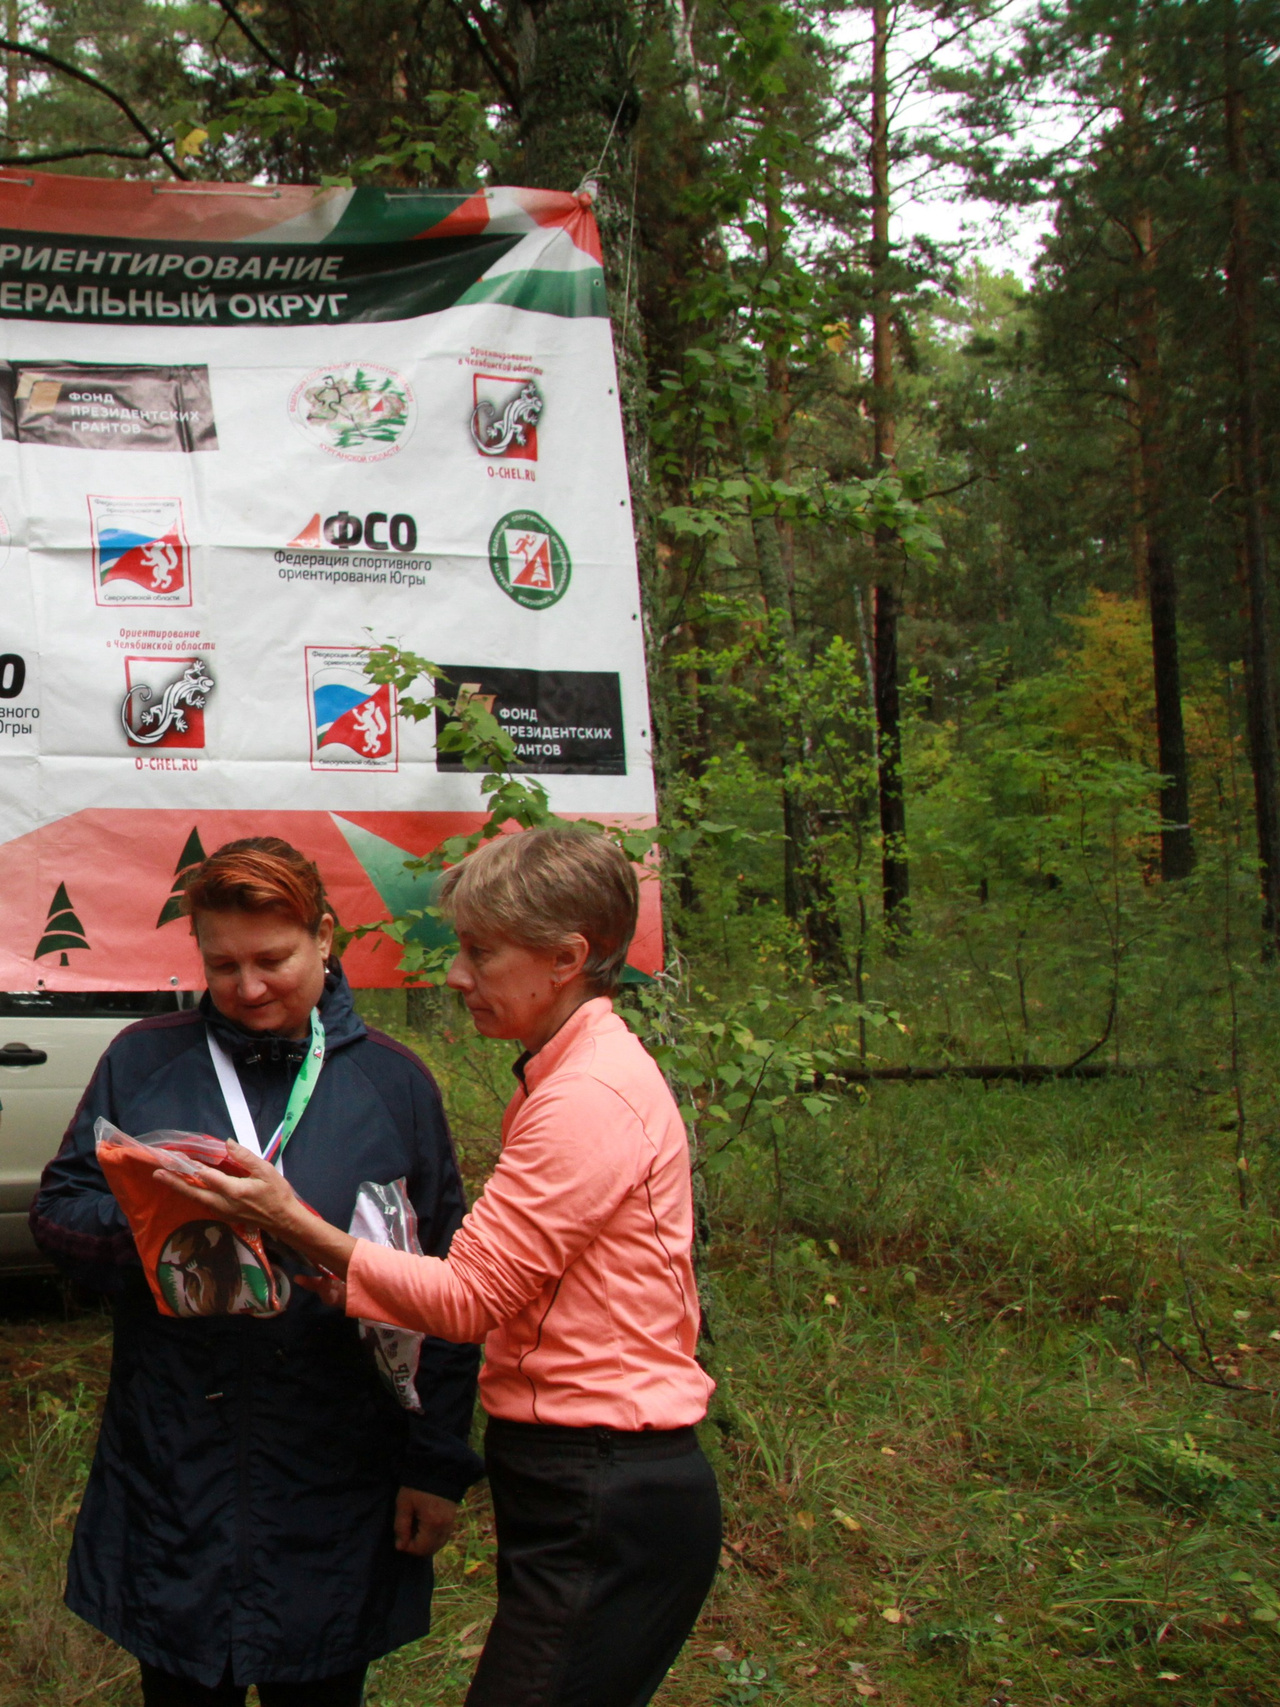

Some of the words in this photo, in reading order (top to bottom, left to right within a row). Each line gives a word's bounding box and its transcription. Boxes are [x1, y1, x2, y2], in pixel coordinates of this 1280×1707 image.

[228, 293, 348, 319] ОКРУГ
[470, 347, 532, 360] Ориентирование
[69, 392, 115, 404] ФОНД
[71, 405, 200, 421] ПРЕЗИДЕНТСКИХ
[72, 421, 141, 434] ГРАНТОВ
[487, 466, 536, 481] O-CHEL.RU
[323, 511, 417, 552] ФСО
[274, 550, 349, 568] Федерация
[353, 556, 432, 571] спортивного
[279, 568, 387, 584] ориентирования
[390, 571, 426, 588] Югры
[120, 628, 200, 640] Ориентирование
[106, 640, 111, 648] в
[114, 639, 172, 651] Челябинской
[175, 641, 216, 651] области
[499, 708, 538, 722] ФОНД
[513, 744, 561, 755] АНТОВ
[135, 757, 198, 771] O-CHEL.RU
